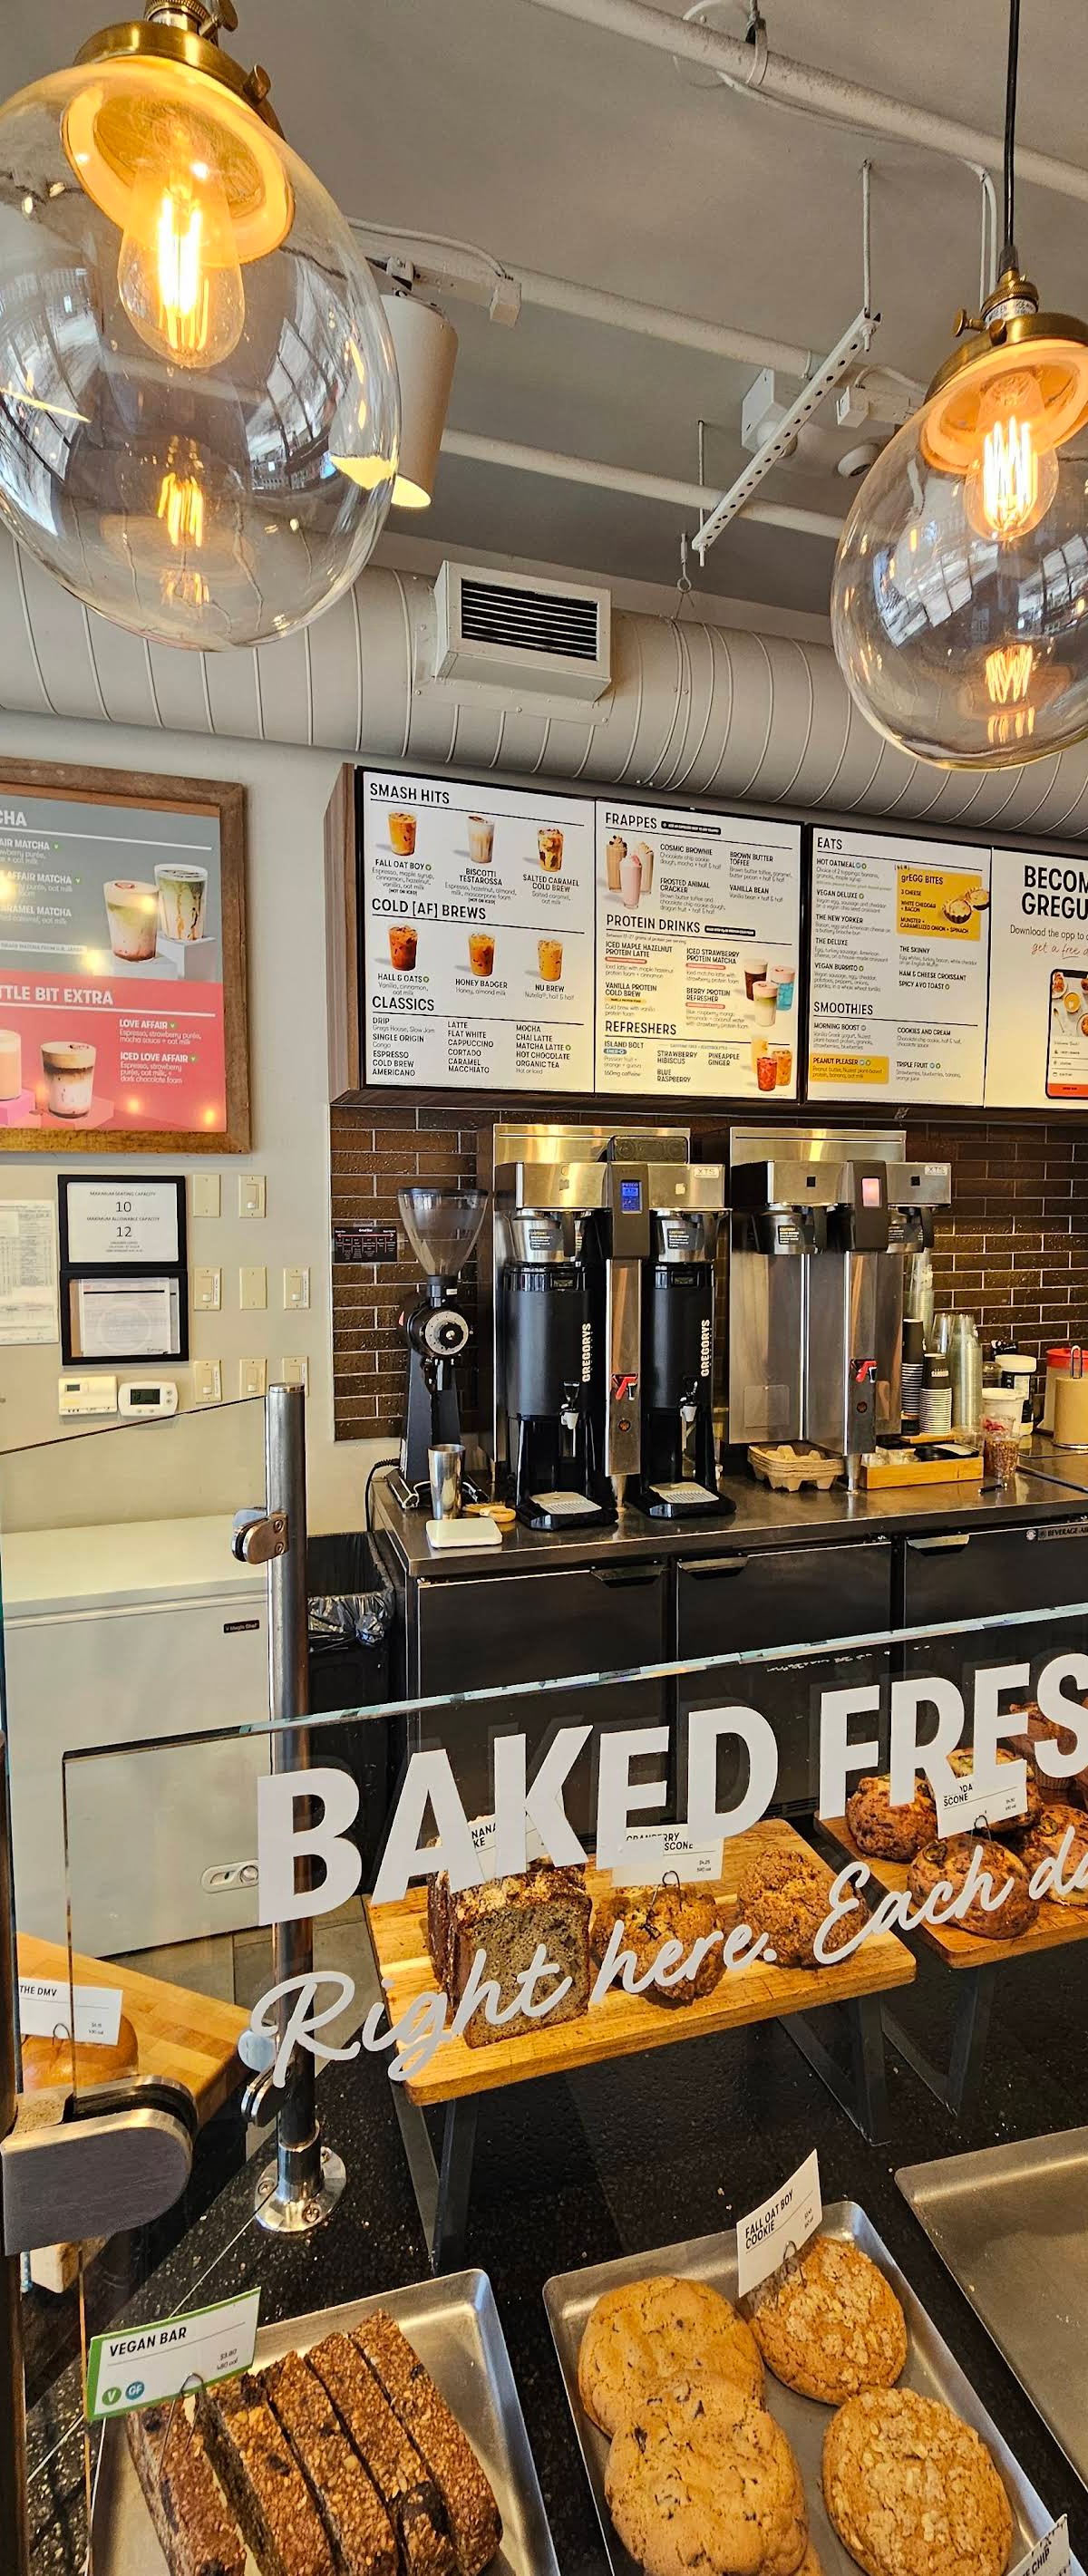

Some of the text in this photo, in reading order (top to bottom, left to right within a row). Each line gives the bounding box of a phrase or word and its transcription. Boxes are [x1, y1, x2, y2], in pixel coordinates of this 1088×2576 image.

[370, 782, 450, 804] SMASH HITS
[605, 812, 657, 829] FRAPPES
[15, 839, 50, 850] MATCHA
[817, 837, 842, 850] EATS
[660, 844, 713, 856] COSMIC BROWNIE
[730, 851, 773, 862] BROWN BUTTER
[375, 858, 424, 870] FALL OAT BOY
[730, 858, 750, 867] TOFFEE
[830, 859, 855, 868] OATMEAL
[465, 867, 496, 877] BISCOTTI
[37, 873, 72, 885] MATCHA
[459, 875, 502, 886] TESTAROSSA
[522, 874, 579, 886] SALTED CARAMEL
[660, 877, 710, 889] FROSTED ANIMAL
[925, 876, 943, 885] BITES
[532, 883, 570, 893] COLD BREW
[660, 885, 688, 894] CRACKER
[729, 884, 770, 895] VANILLA BEAN
[837, 891, 858, 899] DELUXE
[37, 906, 72, 917] MATCHA
[372, 898, 486, 920] COLD [AF] BREWS
[1022, 892, 1088, 920] GREGU
[607, 914, 656, 929] PROTEIN
[659, 918, 701, 934] DRINKS
[841, 915, 863, 924] YORKER
[1010, 924, 1084, 941] Download the app to
[622, 942, 641, 950] MAPLE
[643, 944, 673, 953] HAZELNUT
[827, 938, 848, 946] DELUXE
[632, 950, 650, 958] LATTE
[686, 947, 740, 958] ICED STRAWBERRY
[1031, 942, 1080, 957] get a free
[686, 954, 736, 964] PROTEIN MATCHA
[377, 973, 396, 982] HALL
[403, 975, 423, 983] OATS
[455, 978, 508, 989] HONEY BADGER
[606, 982, 657, 992] VANILLA PROTEIN
[686, 987, 705, 995] BERRY
[35, 986, 59, 1002] BIT
[63, 988, 113, 1004] EXTRA
[686, 994, 719, 1002] REFRESHER
[372, 996, 434, 1012] CLASSICS
[813, 1001, 873, 1015] SMOOTHIES
[120, 1019, 168, 1030] LOVE AFFAIR
[516, 1024, 541, 1032] MOCHA
[605, 1021, 676, 1035] REFRESHERS
[373, 1033, 424, 1042] SINGLE ORIGIN
[465, 1031, 486, 1039] WHITE
[516, 1033, 532, 1041] CHAI
[447, 1039, 493, 1048] CAPPUCCINO
[604, 1040, 627, 1048] ISLAND
[121, 1051, 189, 1062] ICED LOVE AFFAIR
[373, 1051, 409, 1059] ESPRESSO
[448, 1048, 481, 1057] CORTADO
[530, 1051, 570, 1060] CHOCOLATE
[656, 1050, 698, 1059] STRAWBERRY
[708, 1052, 740, 1060] PINEAPPLE
[373, 1059, 414, 1068] COLD BREW
[448, 1058, 481, 1066] CARAMEL
[516, 1060, 547, 1068] ORGANIC
[372, 1069, 415, 1077] AMERICANO
[448, 1065, 490, 1074] MACCHIATO
[656, 1075, 691, 1083] RASPBERRY
[115, 1201, 131, 1213] 10
[116, 1226, 132, 1237] 12
[581, 1322, 591, 1383] GREGORYS
[701, 1319, 711, 1377] GREGORYS
[257, 1652, 1088, 1927] BAKED FRES
[943, 1793, 968, 1807] SCONE
[473, 1837, 486, 1849] KE
[246, 1945, 575, 2088] Right
[591, 1920, 779, 2005] here.
[812, 1844, 1015, 1966] Each
[20, 1985, 58, 1997] THE DMV
[745, 2216, 763, 2239] FALL
[764, 2205, 780, 2223] OAT
[780, 2189, 793, 2211] BOY
[745, 2220, 775, 2250] COOKIE
[110, 2326, 188, 2357] VEGAN BAR
[107, 2384, 143, 2403] V GF
[1032, 2547, 1050, 2574] CHIP
